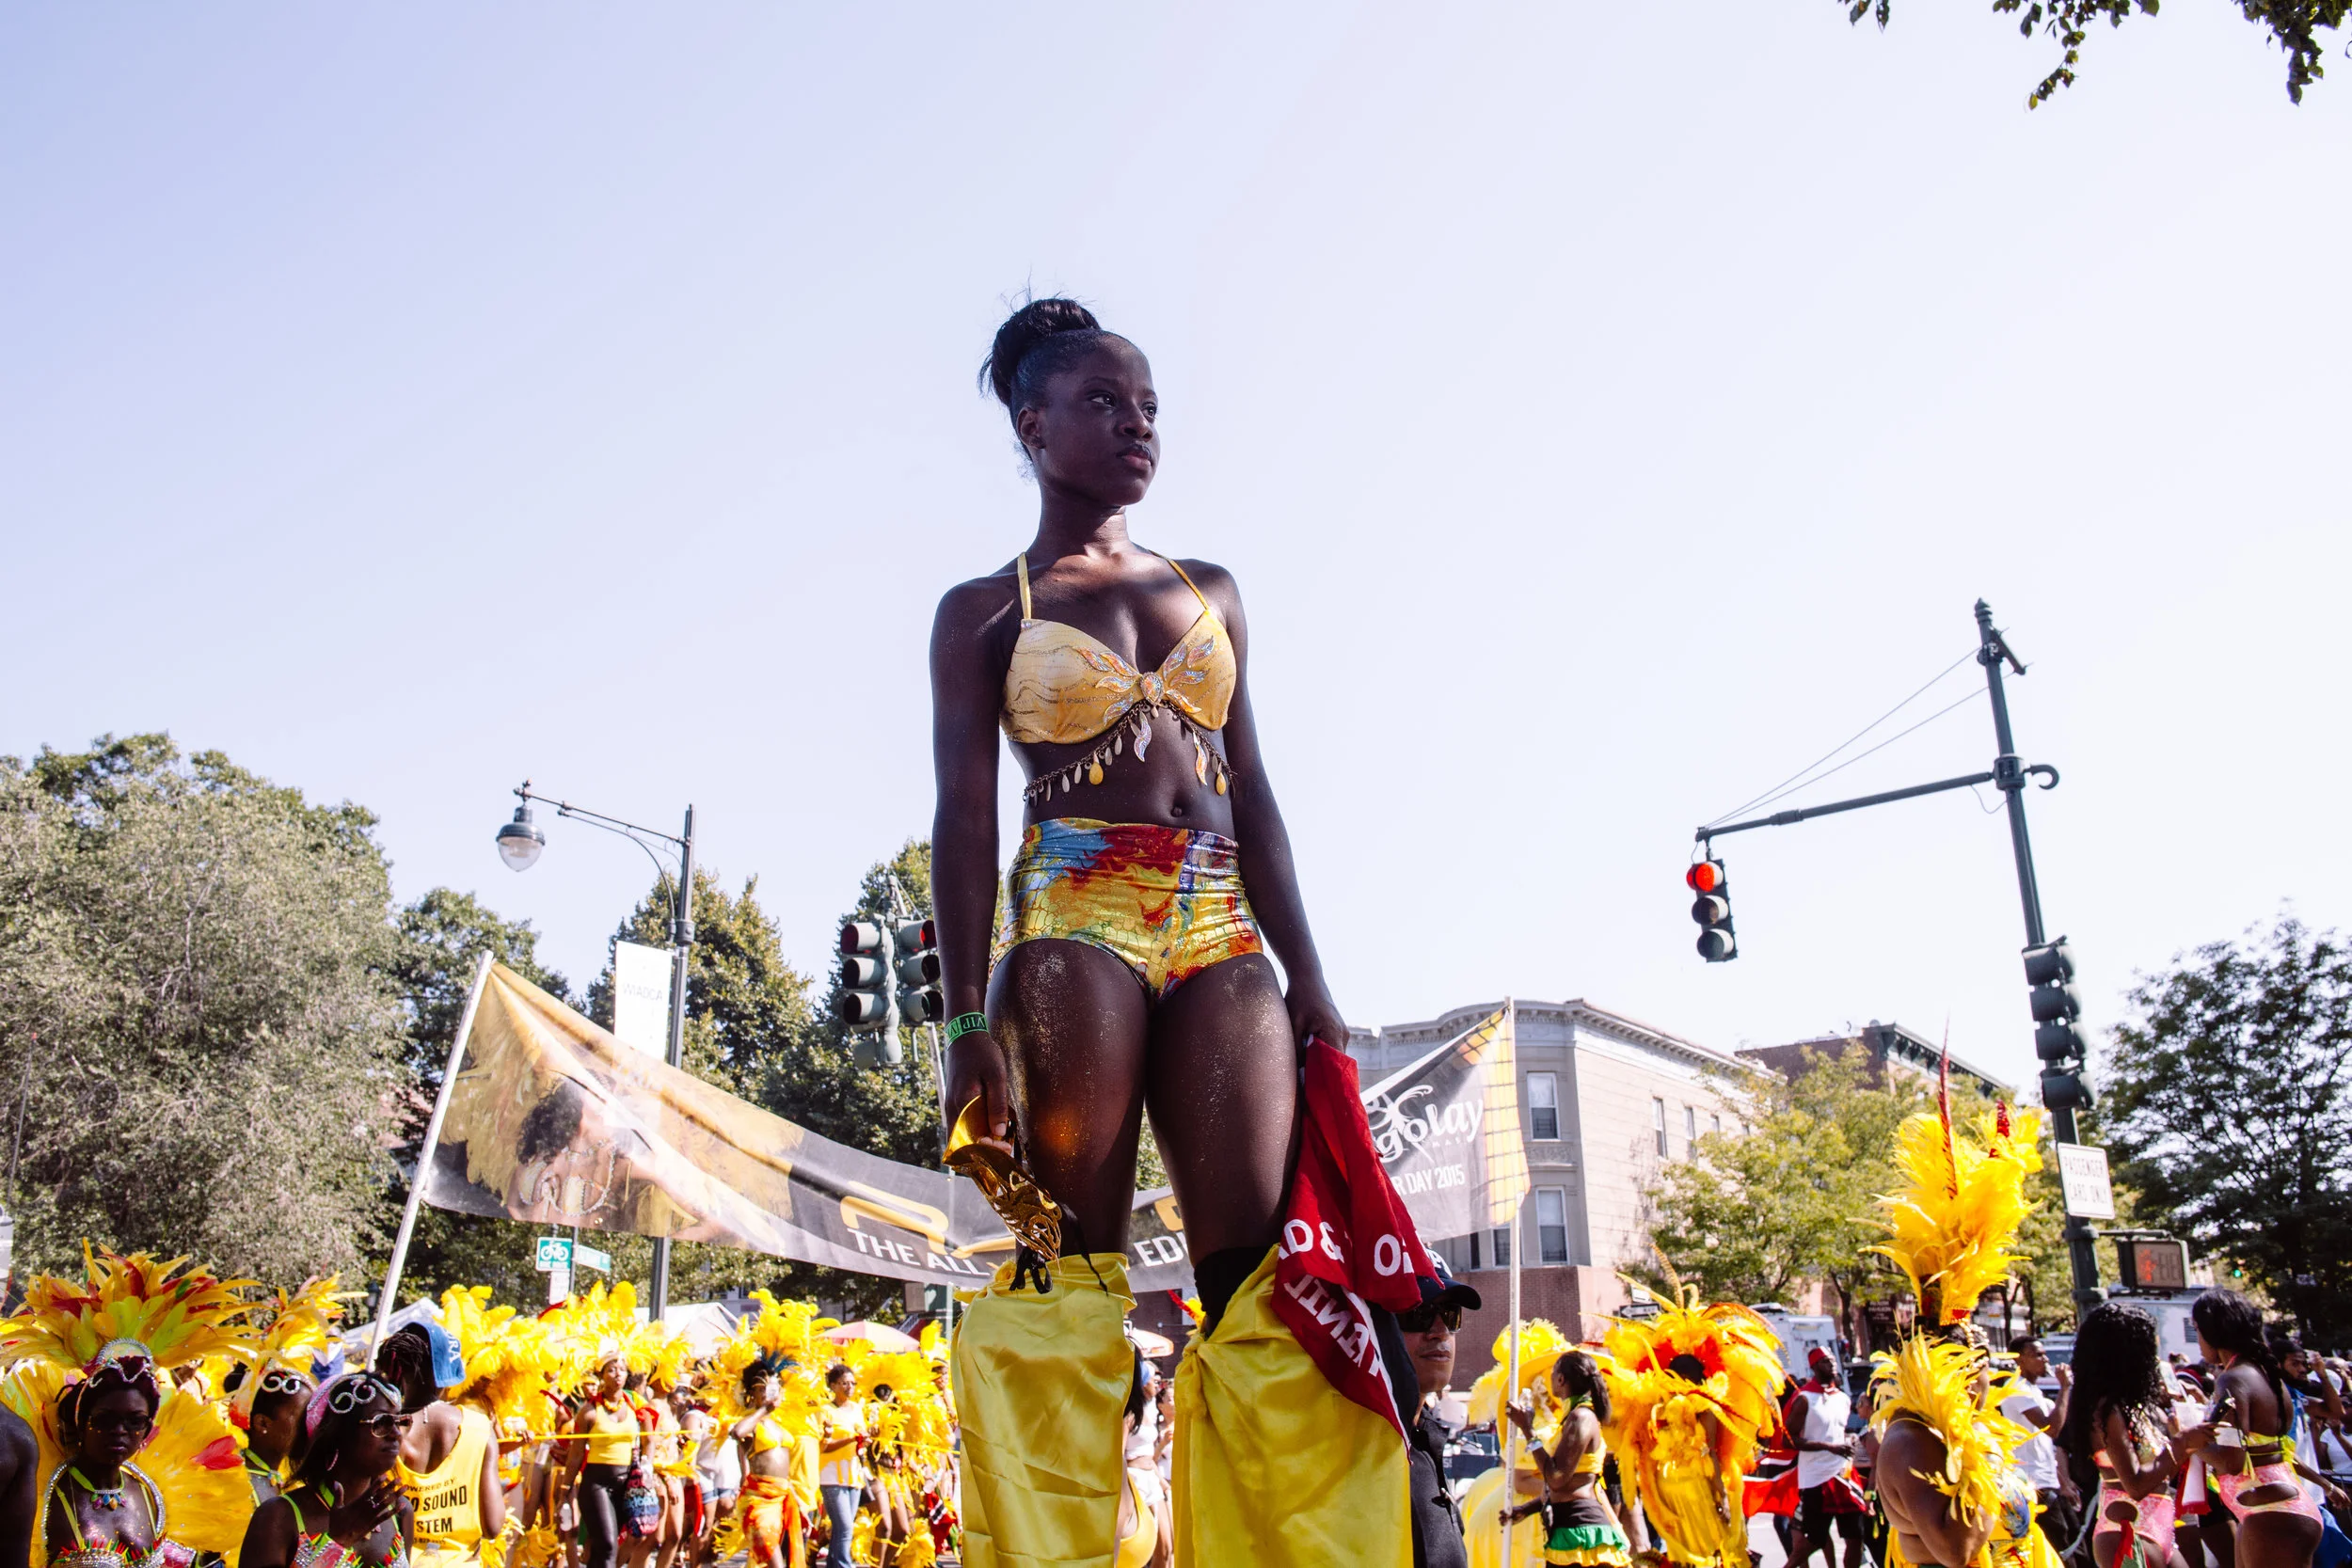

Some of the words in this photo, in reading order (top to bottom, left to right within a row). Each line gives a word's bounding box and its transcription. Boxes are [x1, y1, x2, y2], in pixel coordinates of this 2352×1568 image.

[623, 982, 663, 1001] WIADCA
[962, 1017, 985, 1029] VIP
[1375, 1099, 1484, 1164] golay
[1405, 1169, 1433, 1194] DAY
[1435, 1164, 1465, 1189] 2015
[848, 1228, 920, 1266] THE
[927, 1251, 990, 1275] ALL
[422, 1485, 467, 1512] SOUND
[415, 1517, 453, 1533] STEM
